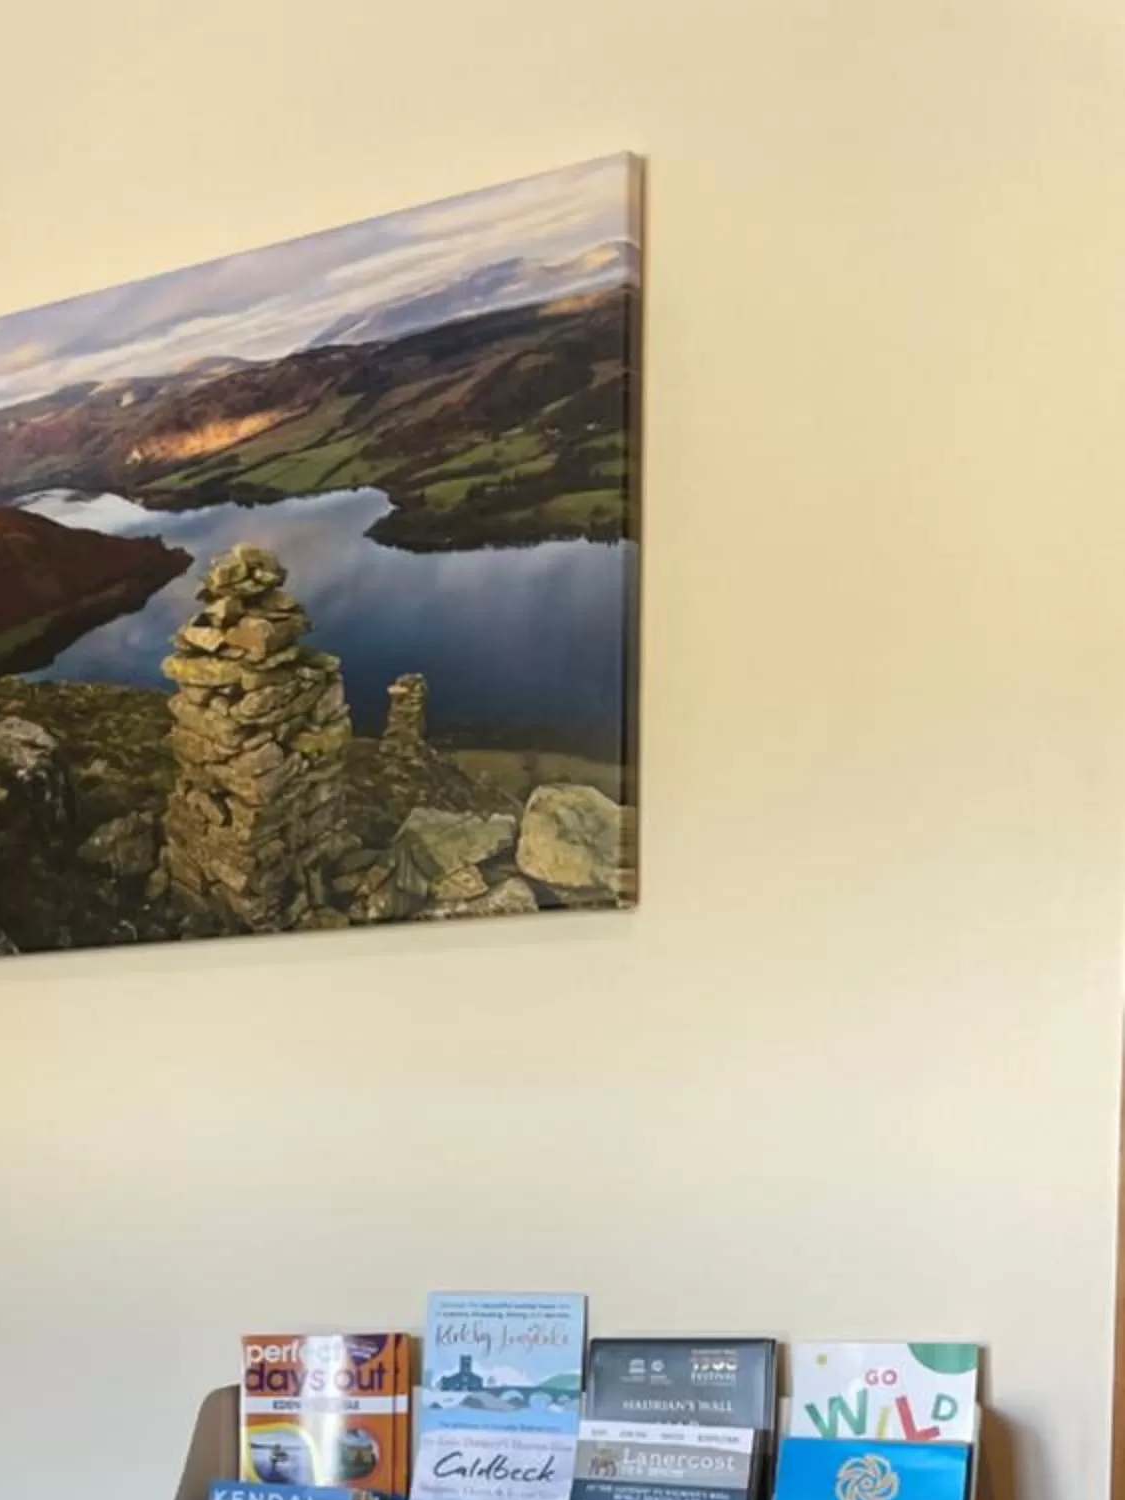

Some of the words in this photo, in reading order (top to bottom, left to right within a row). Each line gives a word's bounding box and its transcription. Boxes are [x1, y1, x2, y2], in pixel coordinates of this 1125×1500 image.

[245, 1340, 345, 1369] perfct
[244, 1361, 327, 1396] days
[332, 1360, 388, 1392] out
[863, 1368, 899, 1387] GO
[803, 1386, 960, 1440] WILD
[432, 1449, 557, 1483] Caldbeck
